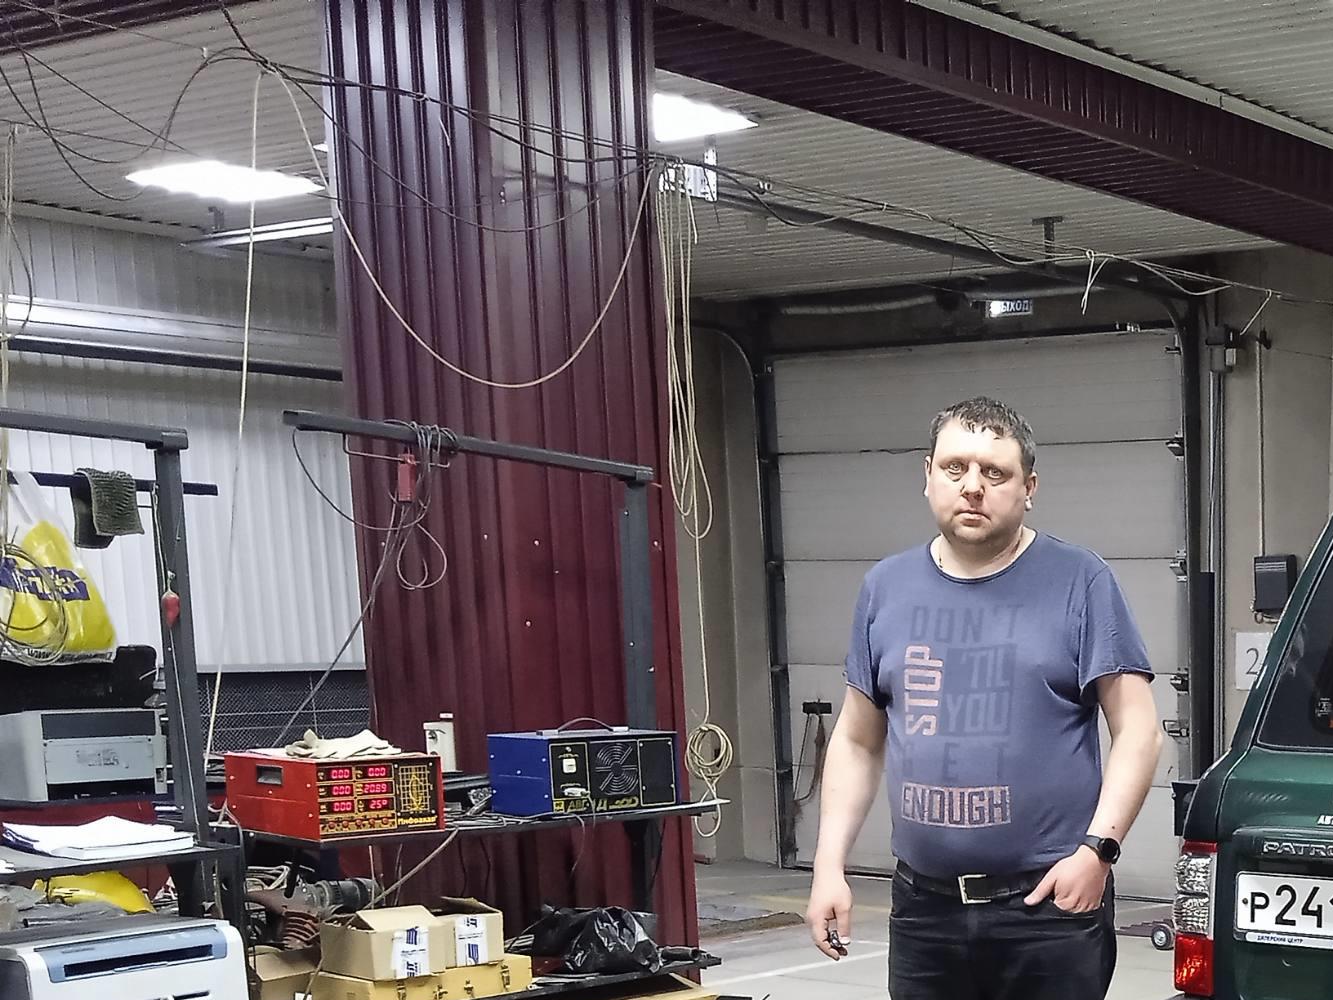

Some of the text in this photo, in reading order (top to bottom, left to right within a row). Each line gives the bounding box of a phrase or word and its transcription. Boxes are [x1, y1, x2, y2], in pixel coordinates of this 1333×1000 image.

[991, 299, 1030, 314] ЫХОД
[910, 604, 1024, 643] DON'T
[962, 647, 1010, 689] 'TIL
[904, 644, 944, 737] STOP
[945, 691, 1010, 733] YOU
[902, 785, 1010, 826] ENOUGH
